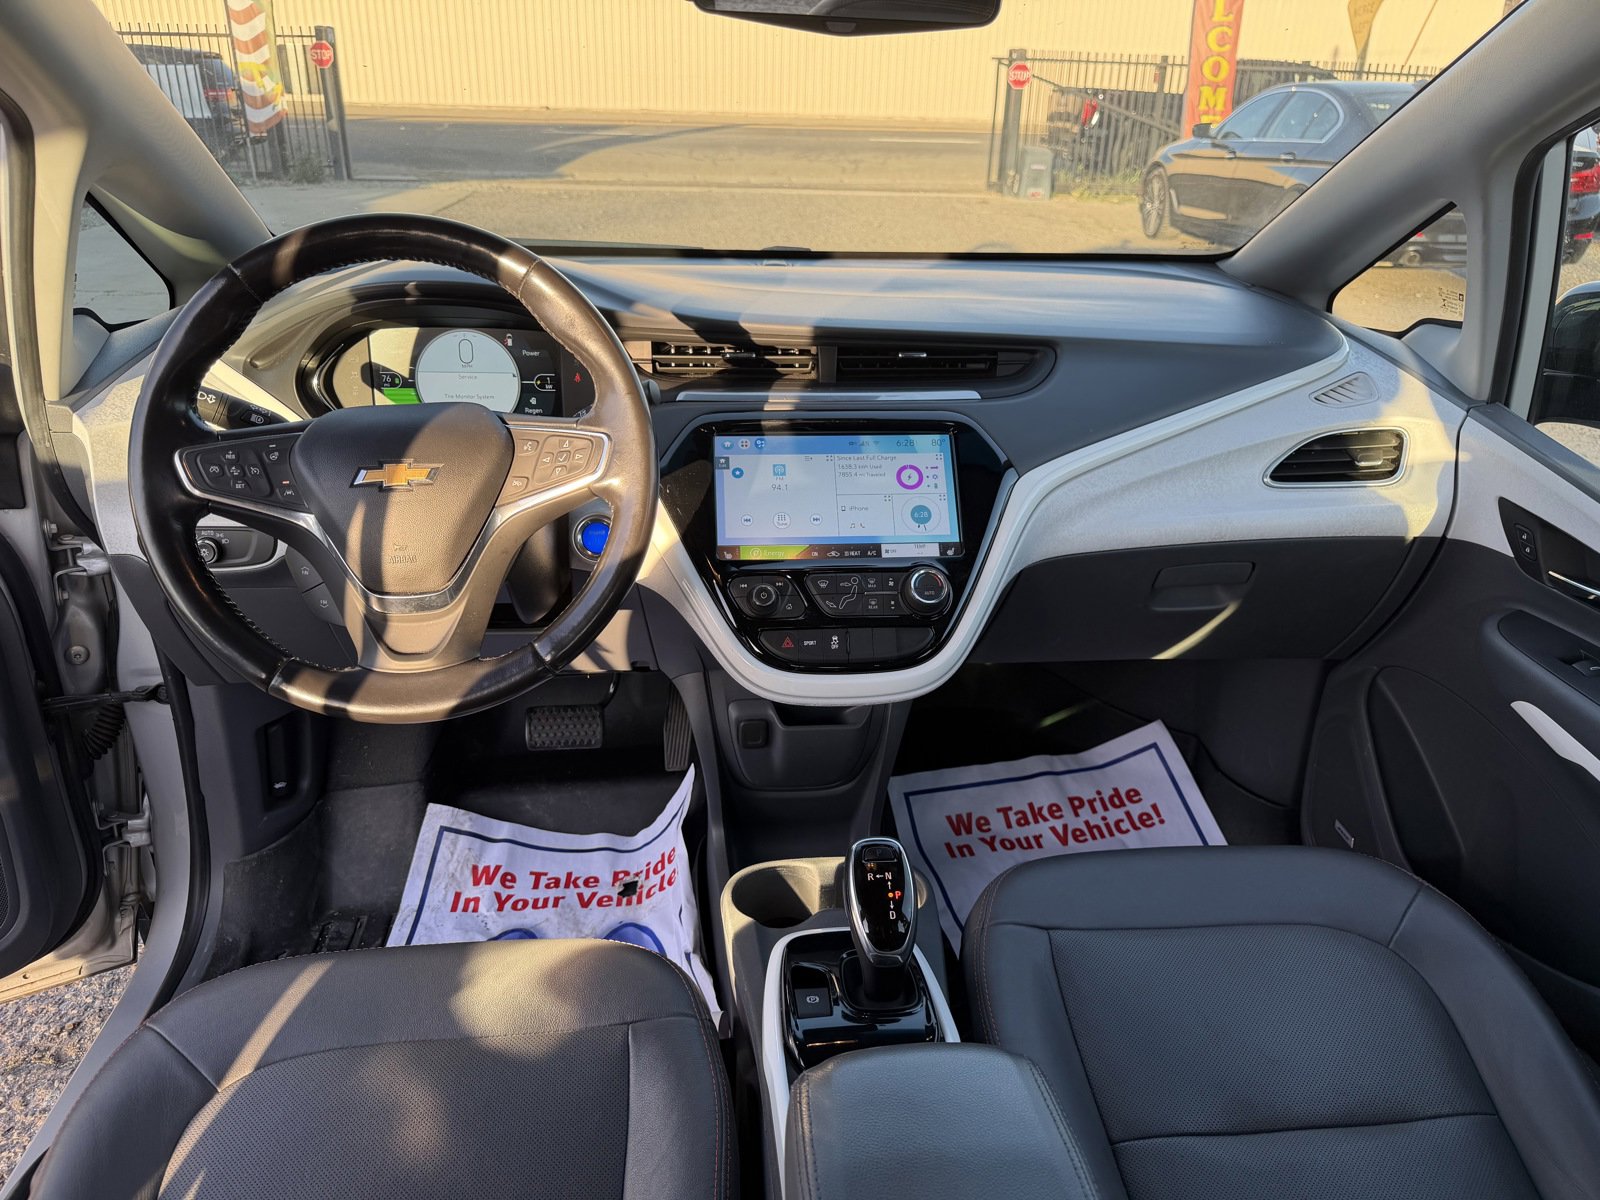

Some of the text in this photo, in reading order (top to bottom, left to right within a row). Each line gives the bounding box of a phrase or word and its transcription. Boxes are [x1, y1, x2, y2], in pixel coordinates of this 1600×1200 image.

[310, 50, 332, 60] STOP
[1008, 71, 1030, 81] STOP
[458, 338, 474, 364] 0
[381, 375, 391, 383] 76
[896, 439, 915, 447] 6:28
[771, 483, 789, 492] 94.1
[763, 549, 785, 557] Energy
[945, 786, 1143, 837] We Take Pride
[944, 802, 1166, 859] In Your Vehicle!
[471, 864, 517, 889] We
[529, 871, 599, 890] Take
[867, 871, 893, 881] R N
[894, 890, 902, 899] P
[449, 891, 481, 913] In
[494, 892, 565, 912] Your
[889, 910, 897, 920] D
